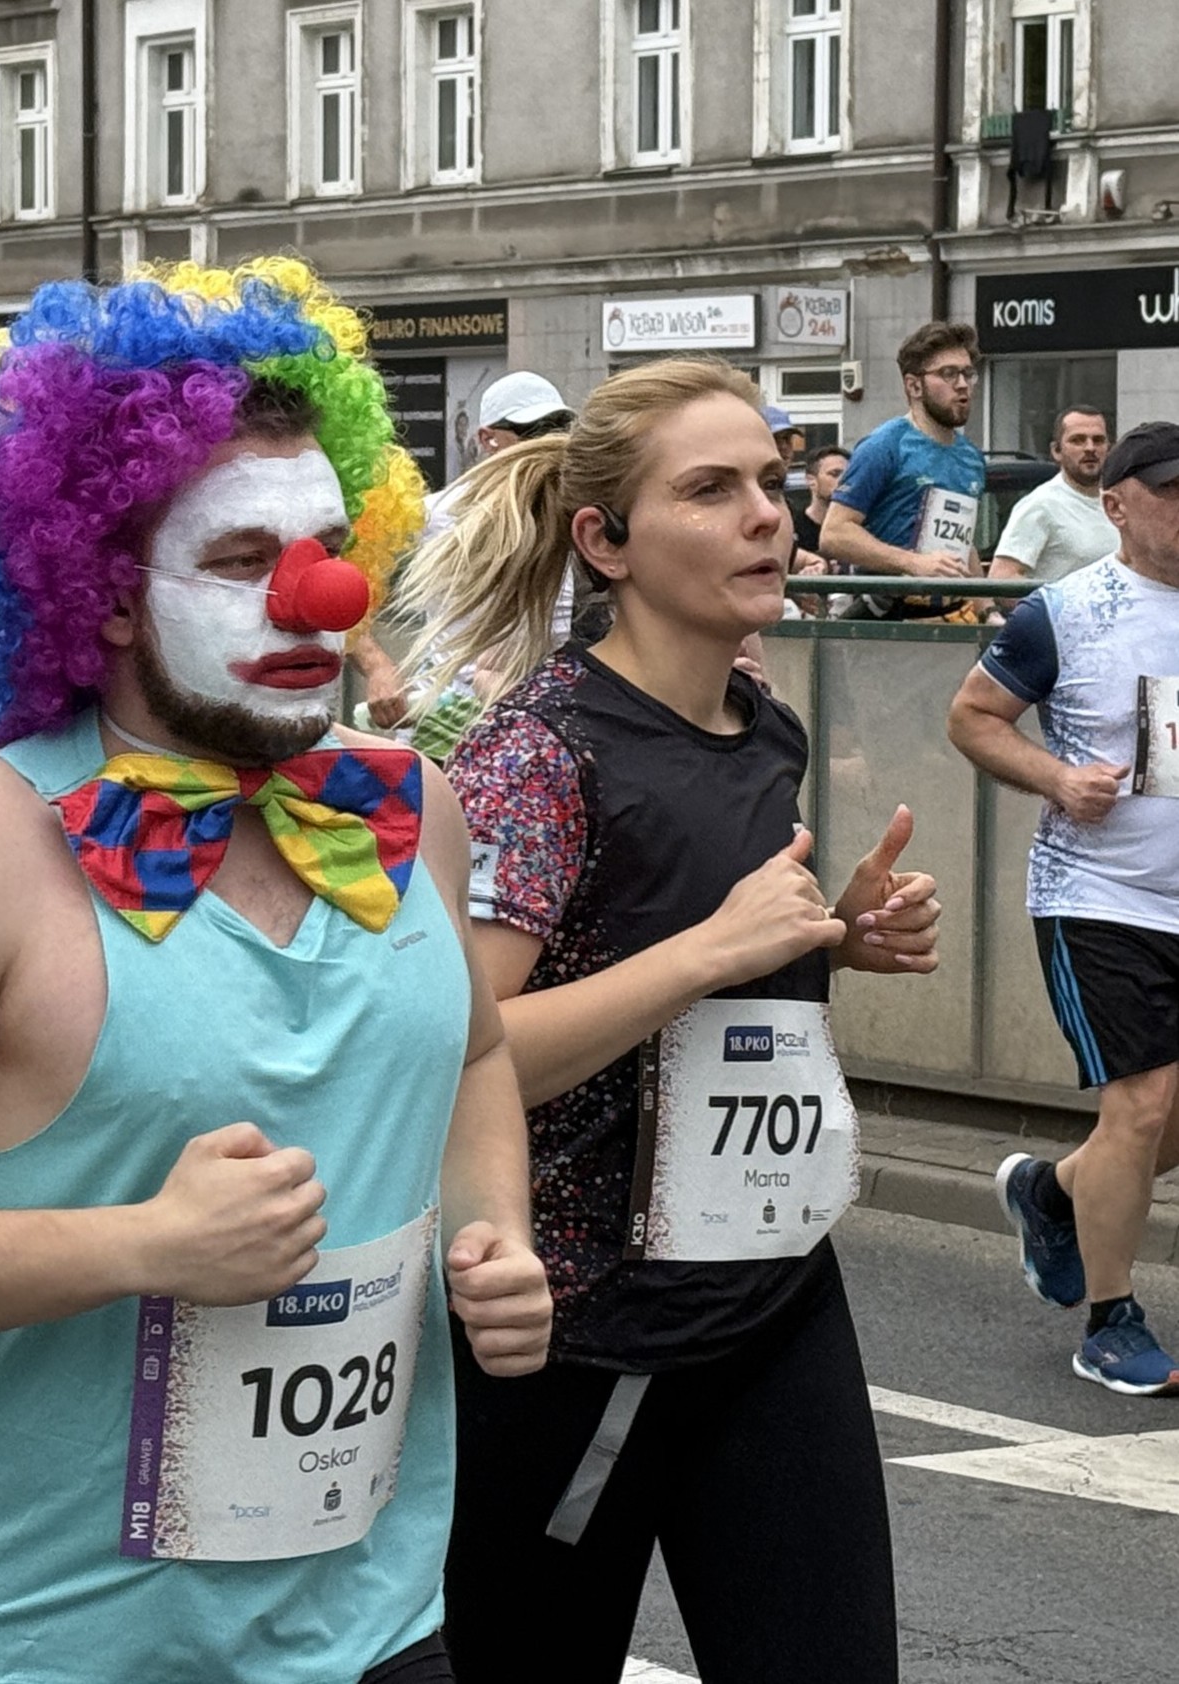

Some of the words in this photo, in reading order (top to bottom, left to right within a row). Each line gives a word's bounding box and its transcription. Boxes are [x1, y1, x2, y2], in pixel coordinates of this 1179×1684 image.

[373, 318, 416, 340] BIURO
[419, 313, 504, 338] FINANSOWE
[808, 318, 836, 337] 24h
[992, 299, 1055, 328] KOMIS
[708, 1094, 823, 1156] 7707
[743, 1169, 791, 1188] Marta
[240, 1340, 398, 1439] 1028
[138, 1437, 154, 1486] GRAWER
[298, 1444, 361, 1474] Oskar
[129, 1500, 152, 1540] M18
